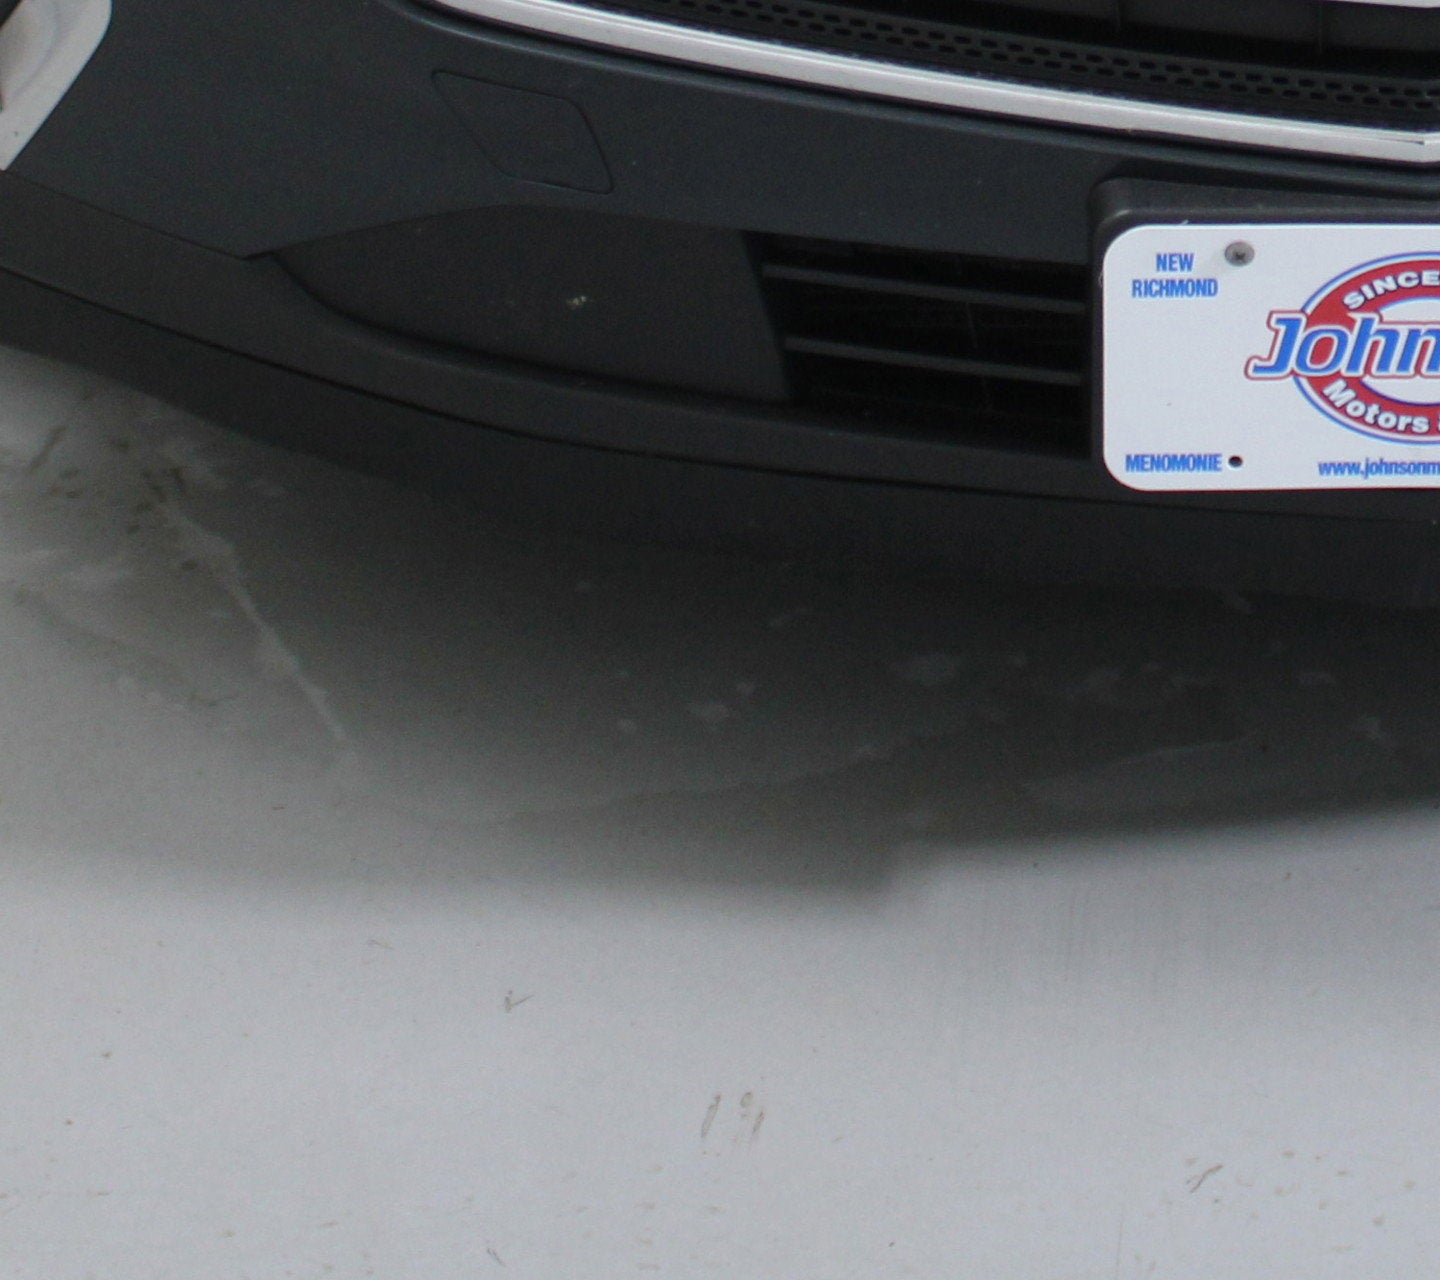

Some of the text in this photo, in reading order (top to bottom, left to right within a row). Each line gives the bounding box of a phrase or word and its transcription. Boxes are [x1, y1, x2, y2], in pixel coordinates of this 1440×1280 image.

[1156, 253, 1194, 271] NEW
[1131, 278, 1218, 297] RICHMOND
[1322, 379, 1430, 434] Motors
[1125, 454, 1222, 472] MENOMONIE
